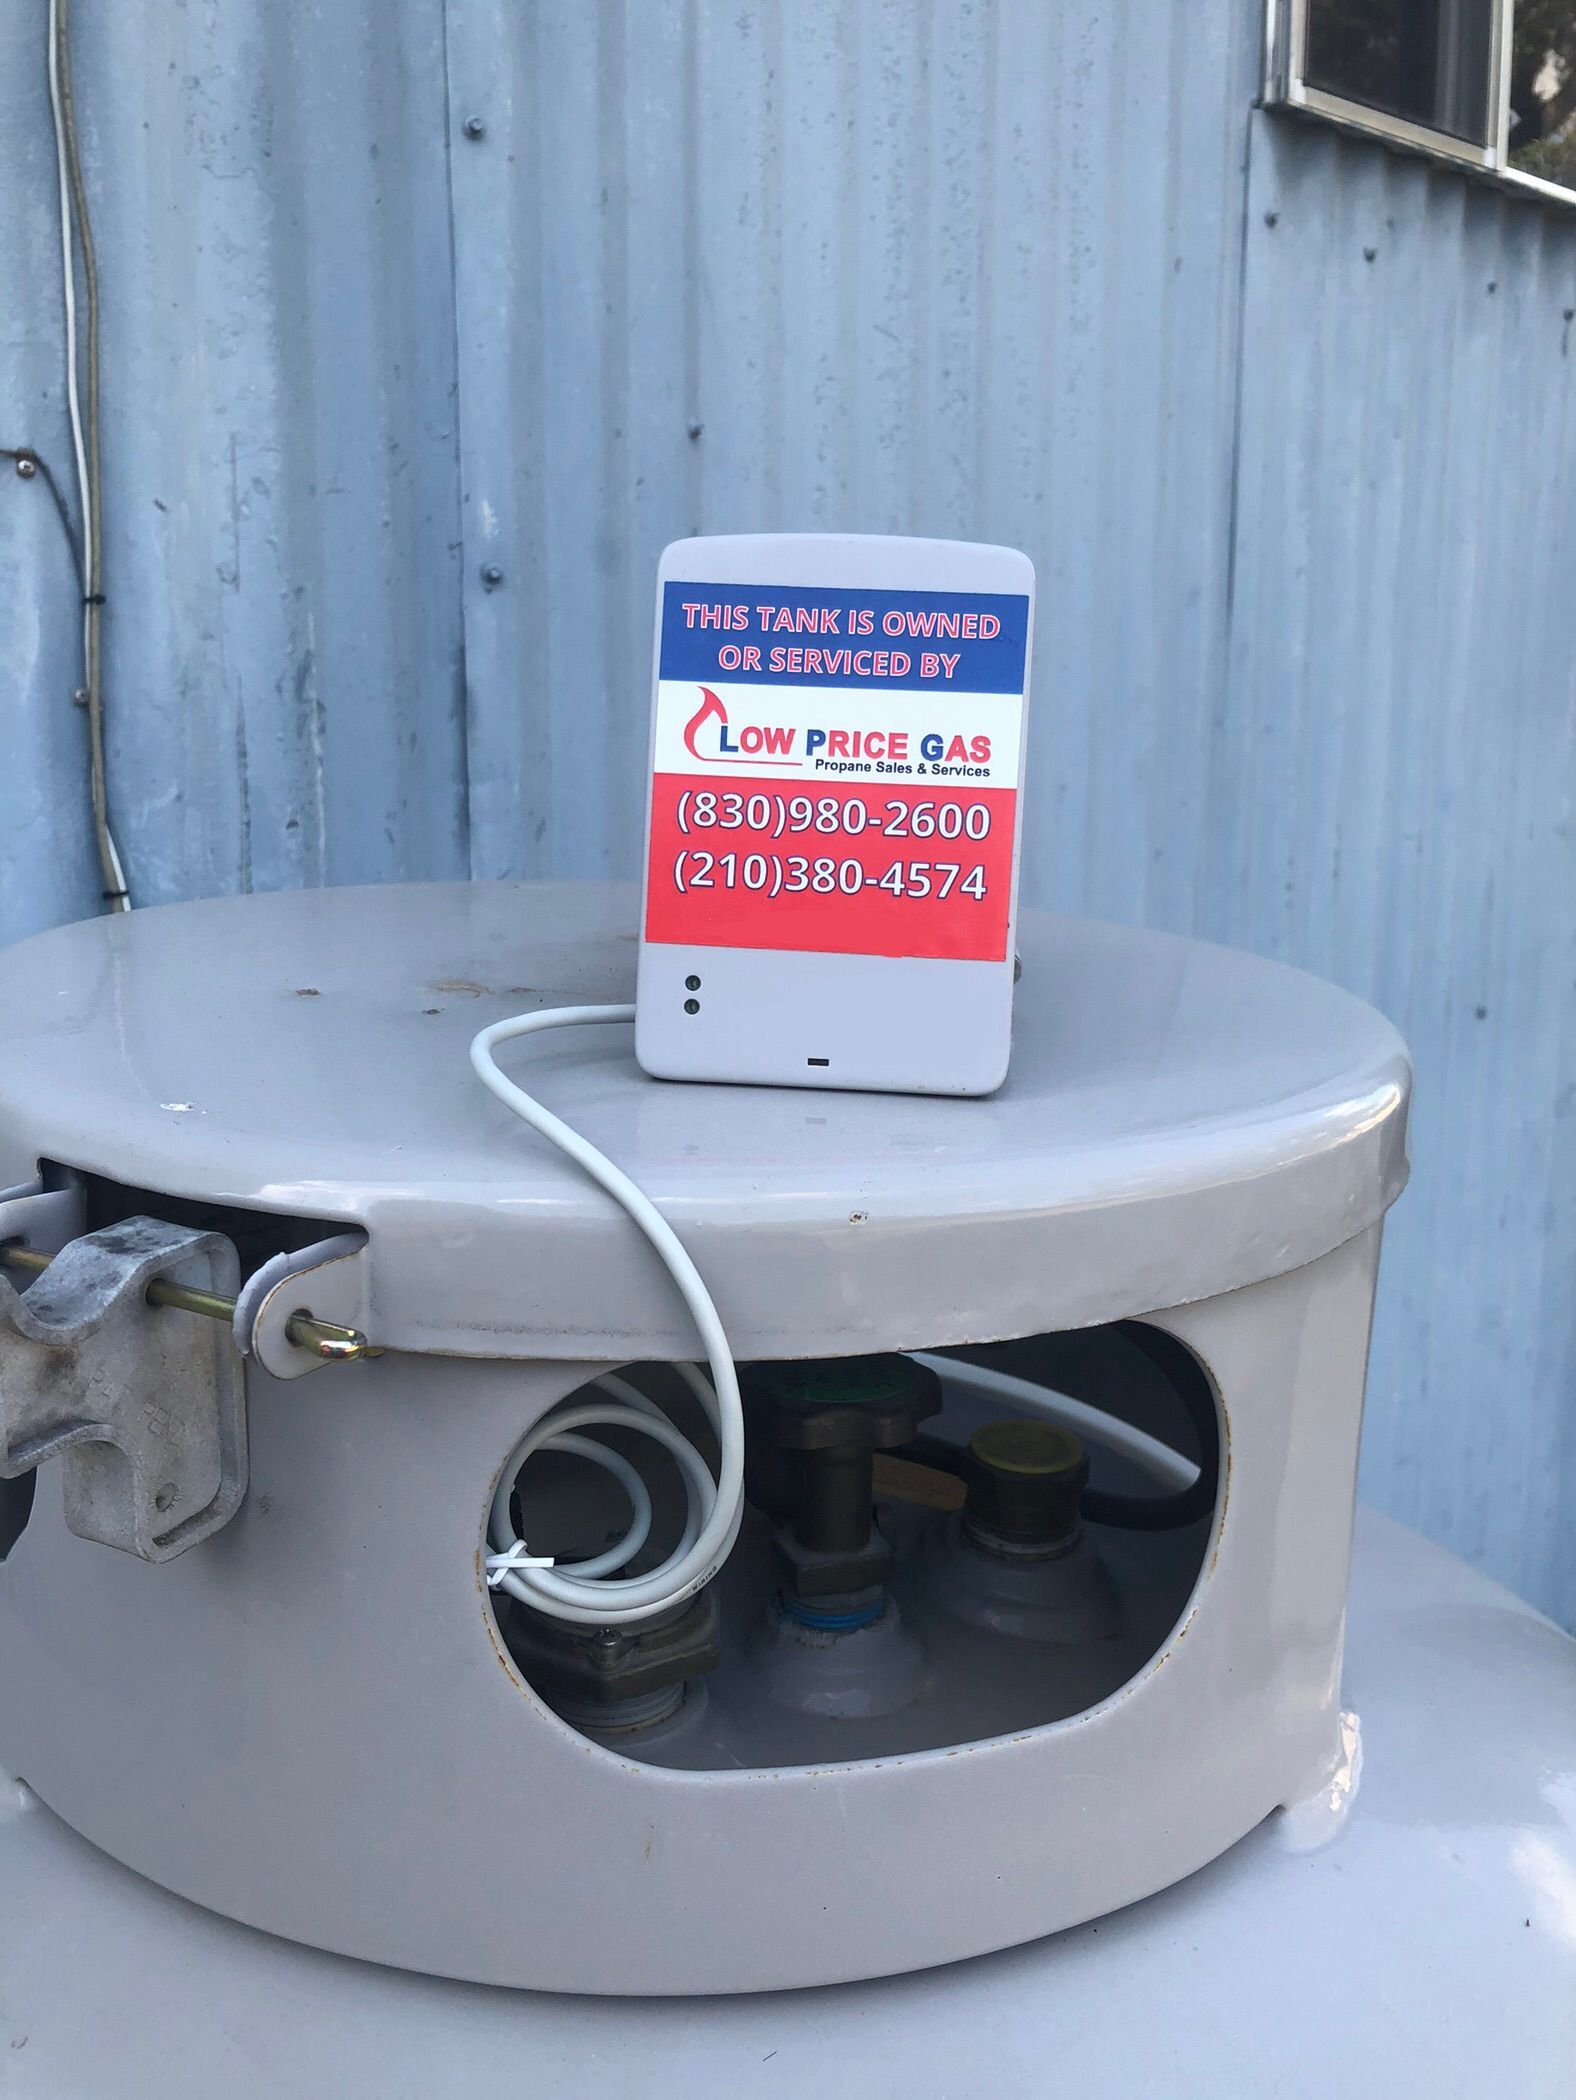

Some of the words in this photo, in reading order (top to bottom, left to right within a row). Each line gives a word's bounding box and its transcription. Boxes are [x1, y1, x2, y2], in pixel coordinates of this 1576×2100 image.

[682, 603, 749, 631] THIS
[757, 606, 841, 634] TANK
[848, 609, 874, 636] IS
[882, 611, 1001, 640] OWNED
[718, 645, 762, 672] OR
[769, 647, 911, 677] SERVICED
[920, 652, 961, 679] BY
[719, 725, 796, 755] LOW
[806, 728, 909, 761] PRICE
[920, 734, 992, 763] GAS
[815, 758, 872, 774] Propane
[876, 761, 913, 775] Sales
[917, 763, 927, 775] &
[931, 763, 991, 778] Services
[676, 791, 991, 841] (830)980-2600
[673, 851, 987, 901] (210)380-4574
